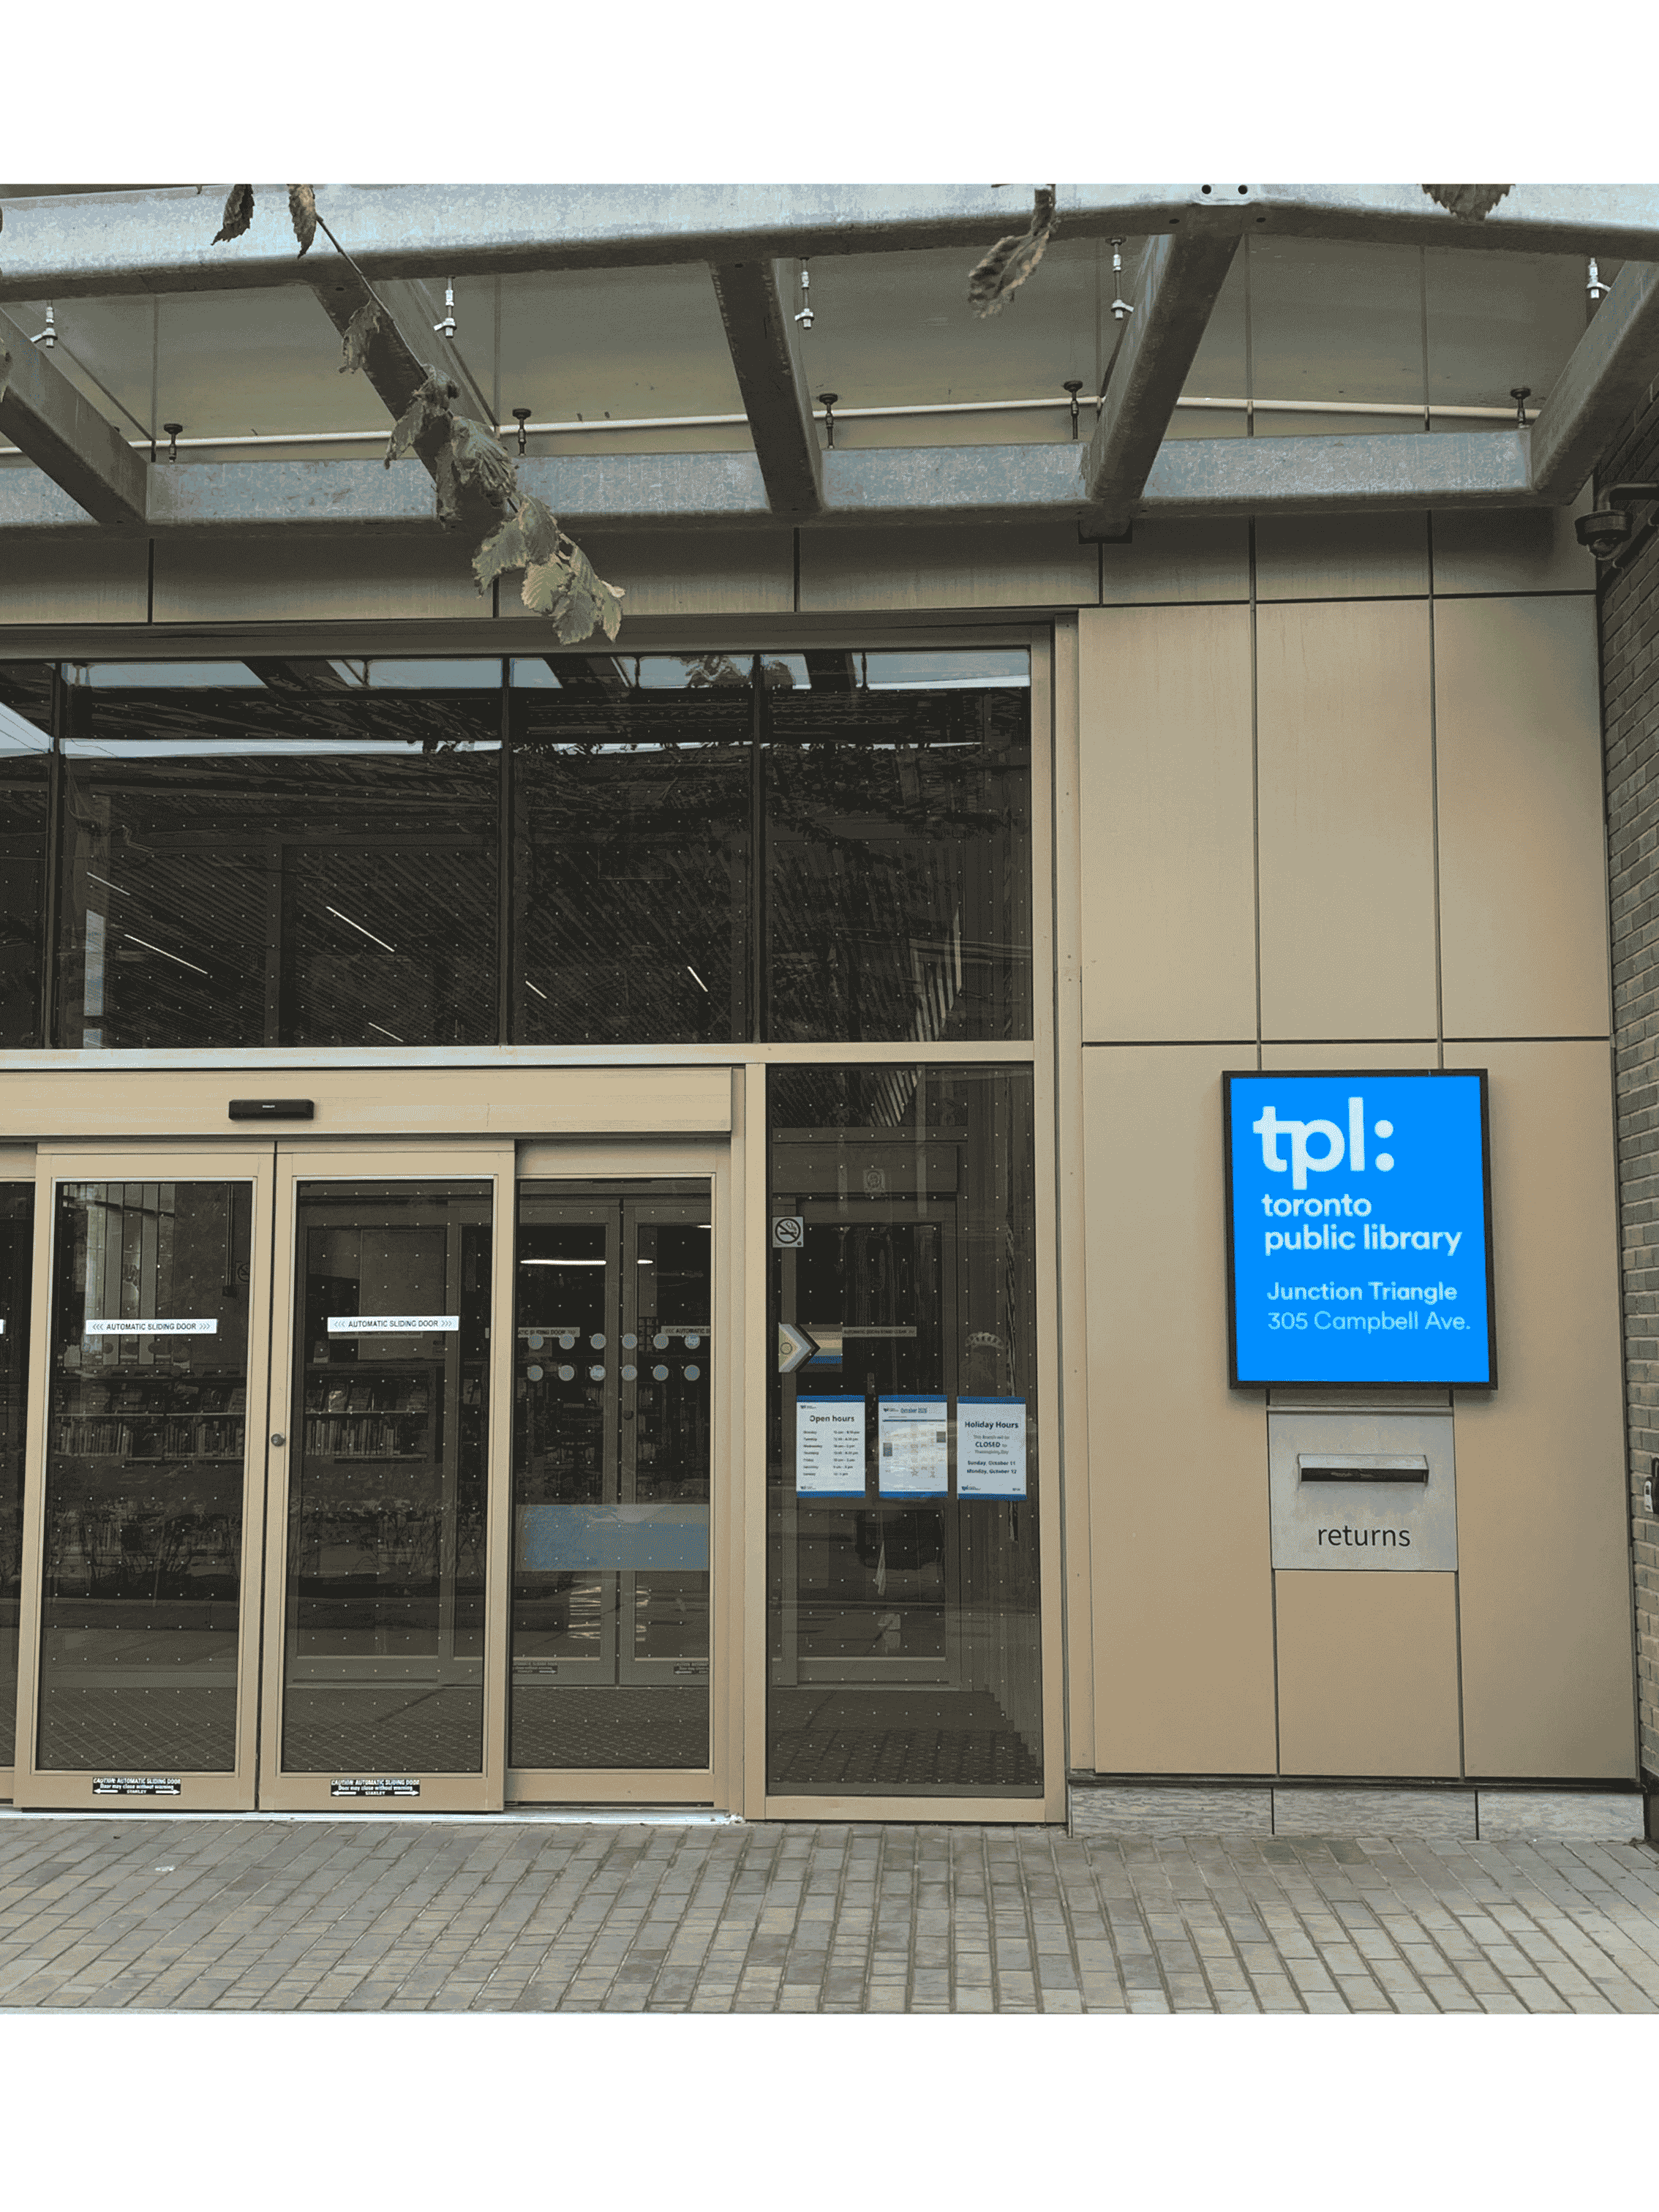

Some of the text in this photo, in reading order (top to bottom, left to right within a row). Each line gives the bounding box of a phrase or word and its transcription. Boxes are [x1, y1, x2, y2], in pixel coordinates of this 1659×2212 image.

[1252, 1096, 1395, 1190] tpl:
[1261, 1194, 1372, 1217] toronto
[1265, 1223, 1463, 1257] public library
[1267, 1282, 1458, 1305] Junction Triangle
[1268, 1311, 1471, 1334] 305 Campbell Ave.
[810, 1415, 830, 1423] Open
[965, 1421, 994, 1430] Holiday
[1318, 1525, 1410, 1546] returns
